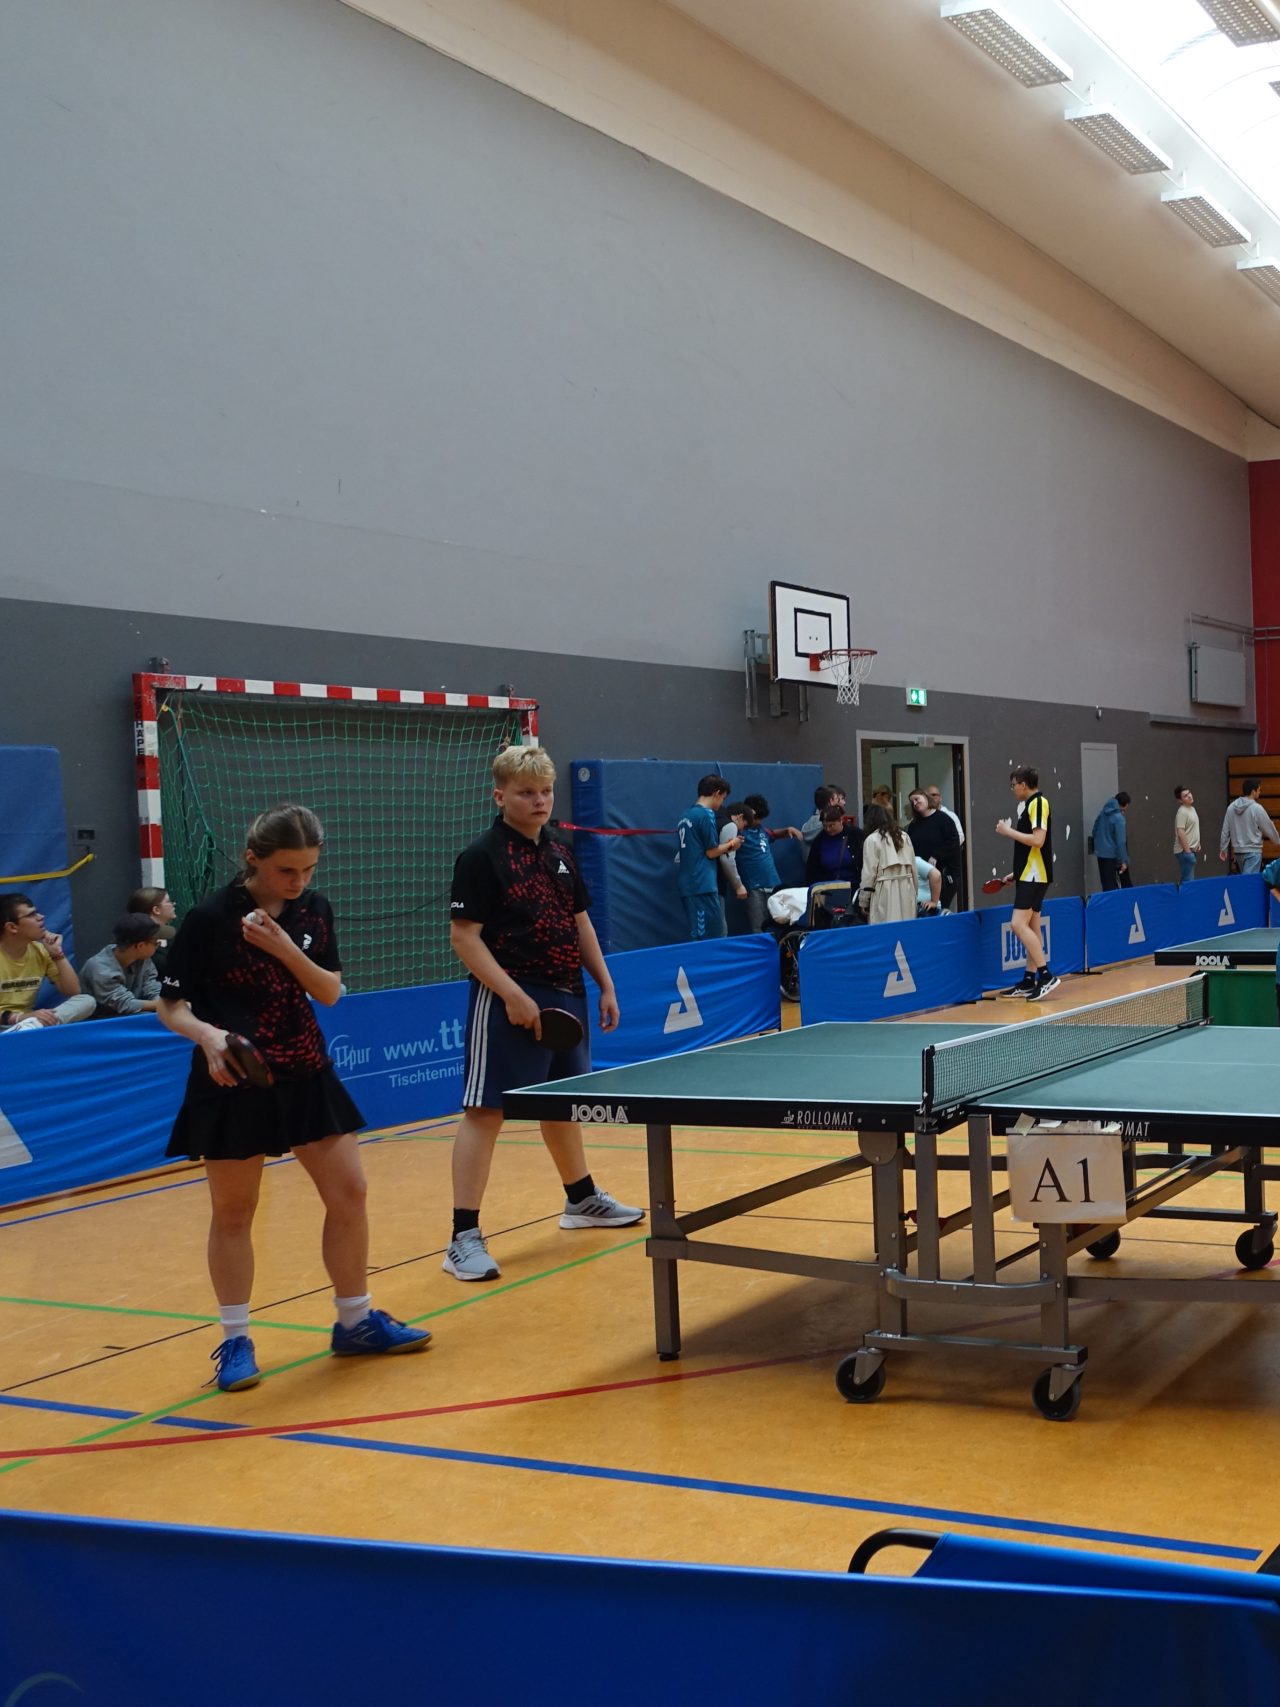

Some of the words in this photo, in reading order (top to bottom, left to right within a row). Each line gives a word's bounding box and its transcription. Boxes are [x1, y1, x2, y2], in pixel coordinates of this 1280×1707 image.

[1195, 955, 1230, 966] JOOLA
[383, 1018, 466, 1061] www.tt
[570, 1104, 629, 1124] JOOLA
[797, 1110, 854, 1126] ROLLOMAT
[1029, 1156, 1096, 1204] A1
